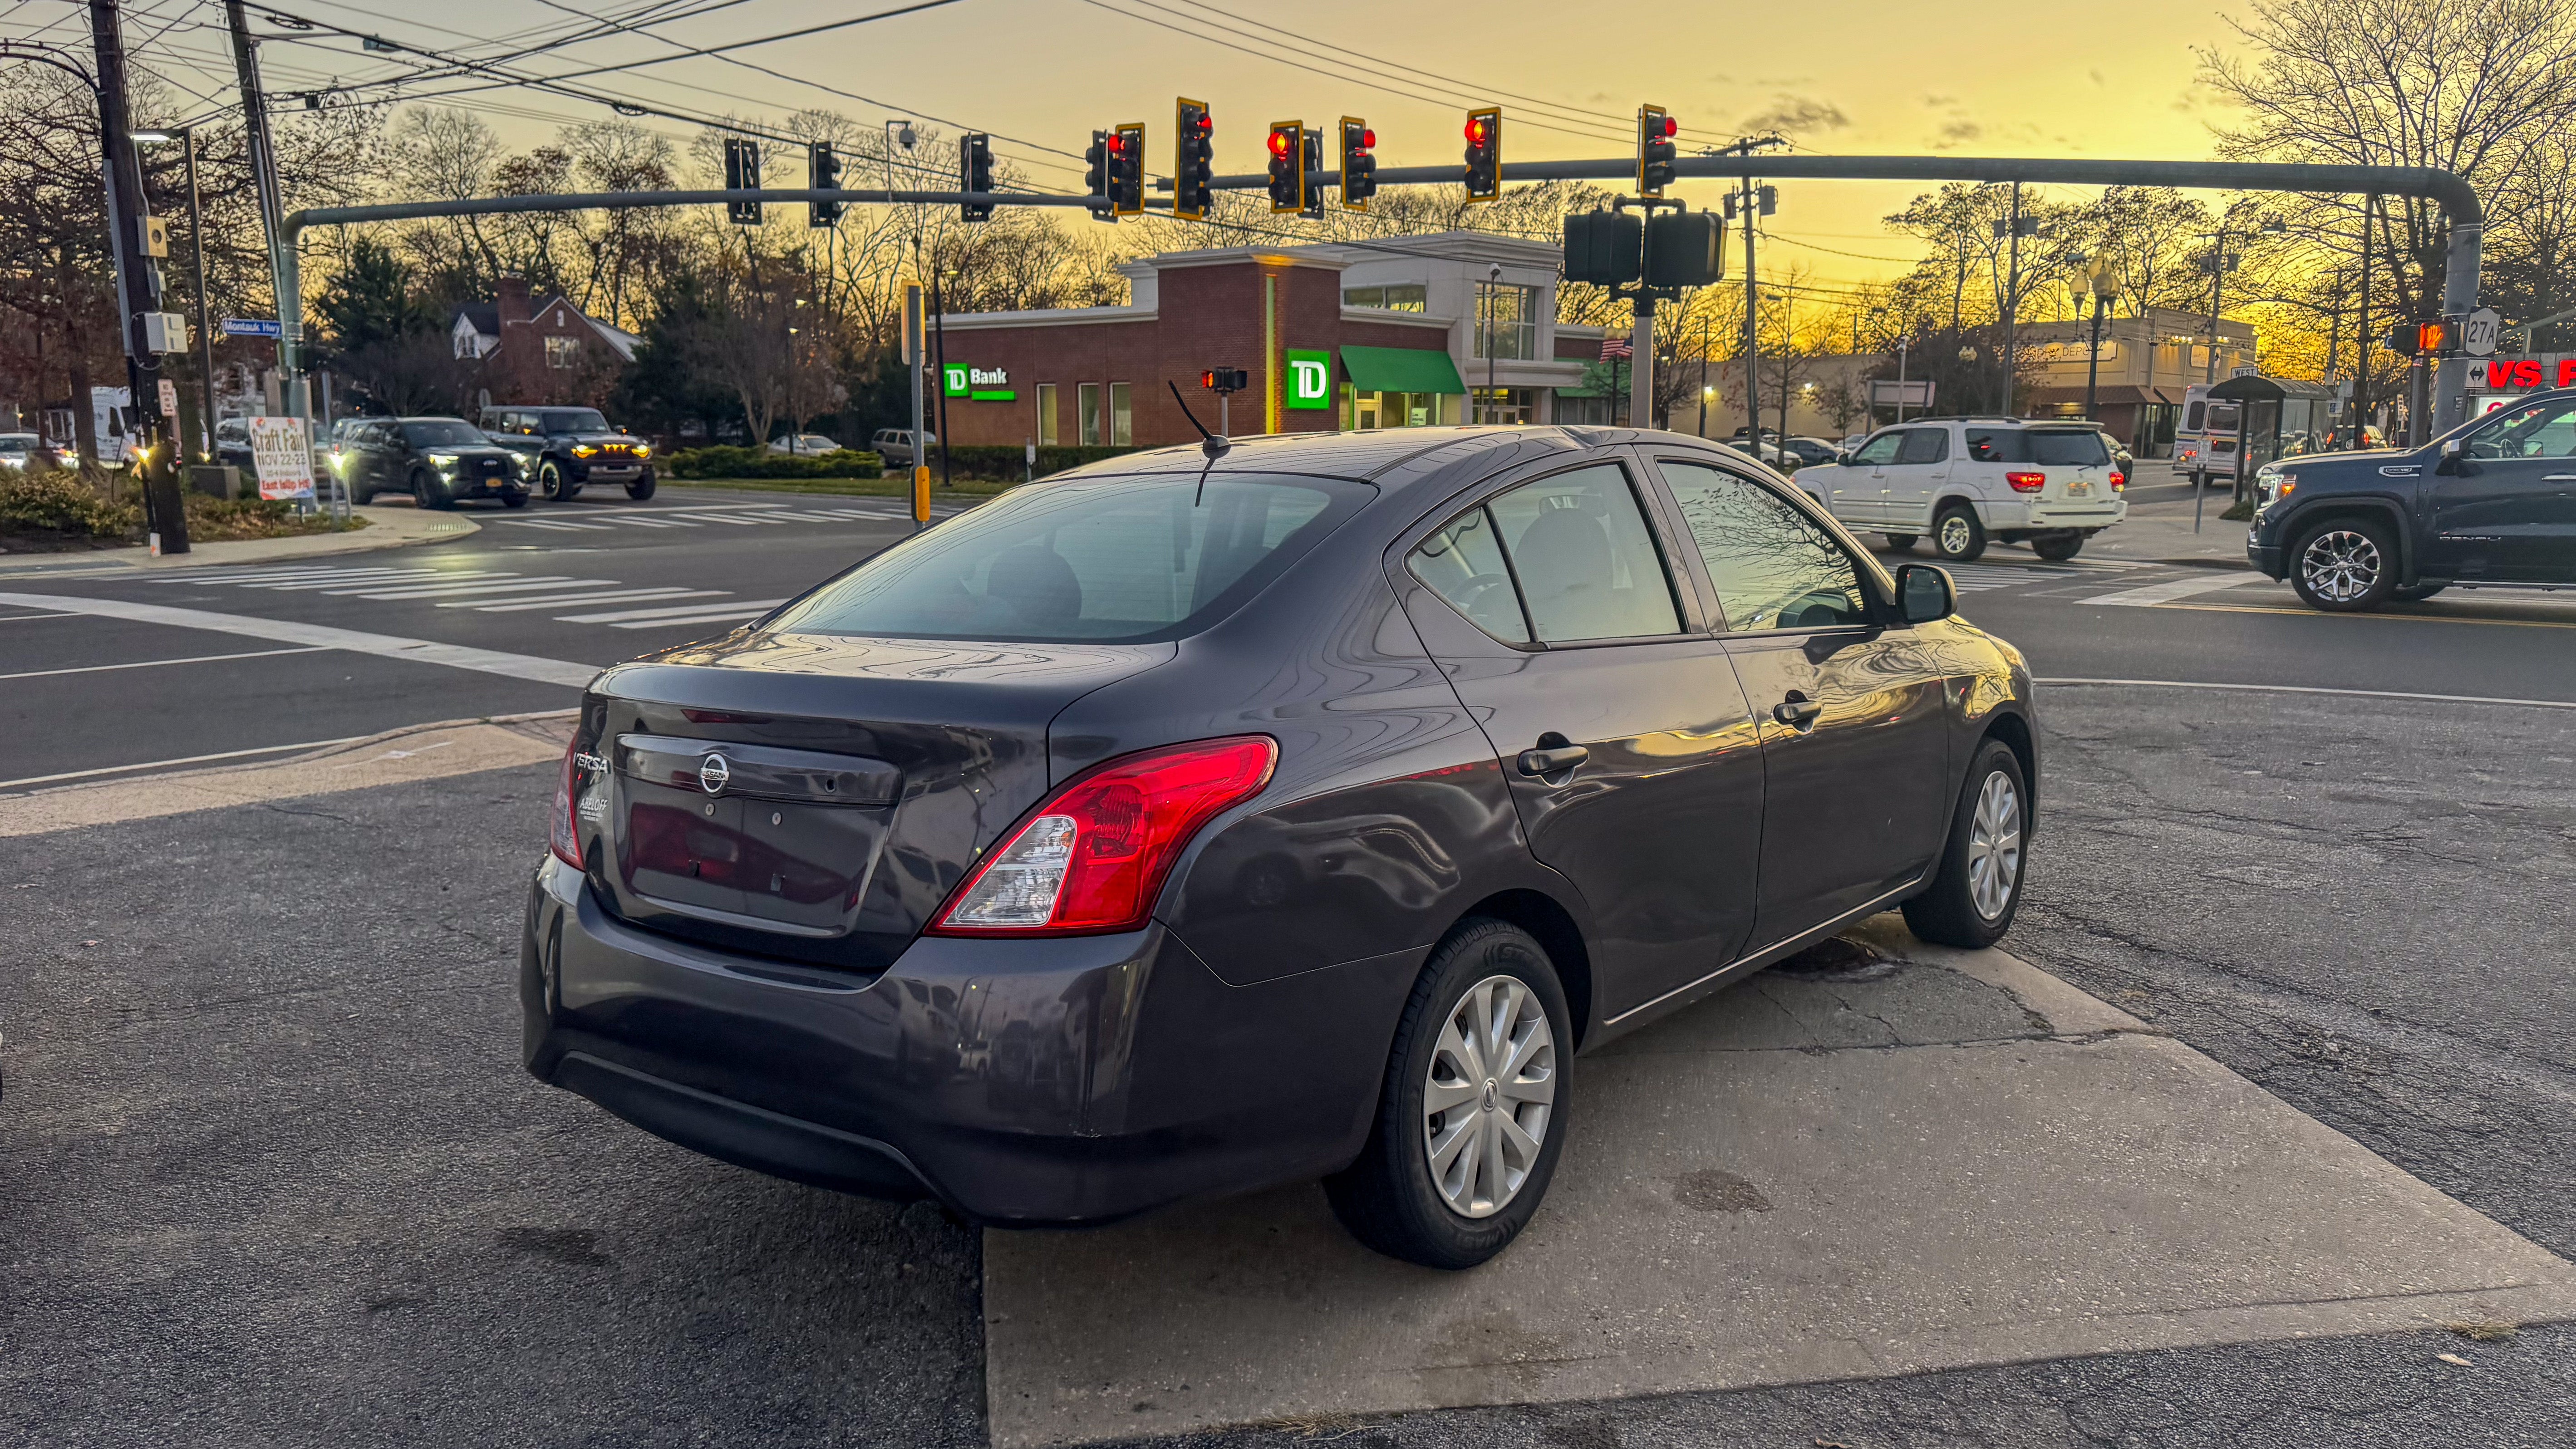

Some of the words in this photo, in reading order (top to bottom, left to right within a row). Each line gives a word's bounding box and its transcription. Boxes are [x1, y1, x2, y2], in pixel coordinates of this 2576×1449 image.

[2468, 321, 2494, 344] 27A
[945, 369, 966, 391] TD
[970, 367, 1007, 385] Bank
[1291, 360, 1327, 398] TD
[2235, 368, 2254, 377] WEST
[252, 428, 282, 452] Craft
[282, 428, 305, 452] Fair
[573, 752, 609, 774] VERSA
[580, 797, 608, 811] ABELOFF
